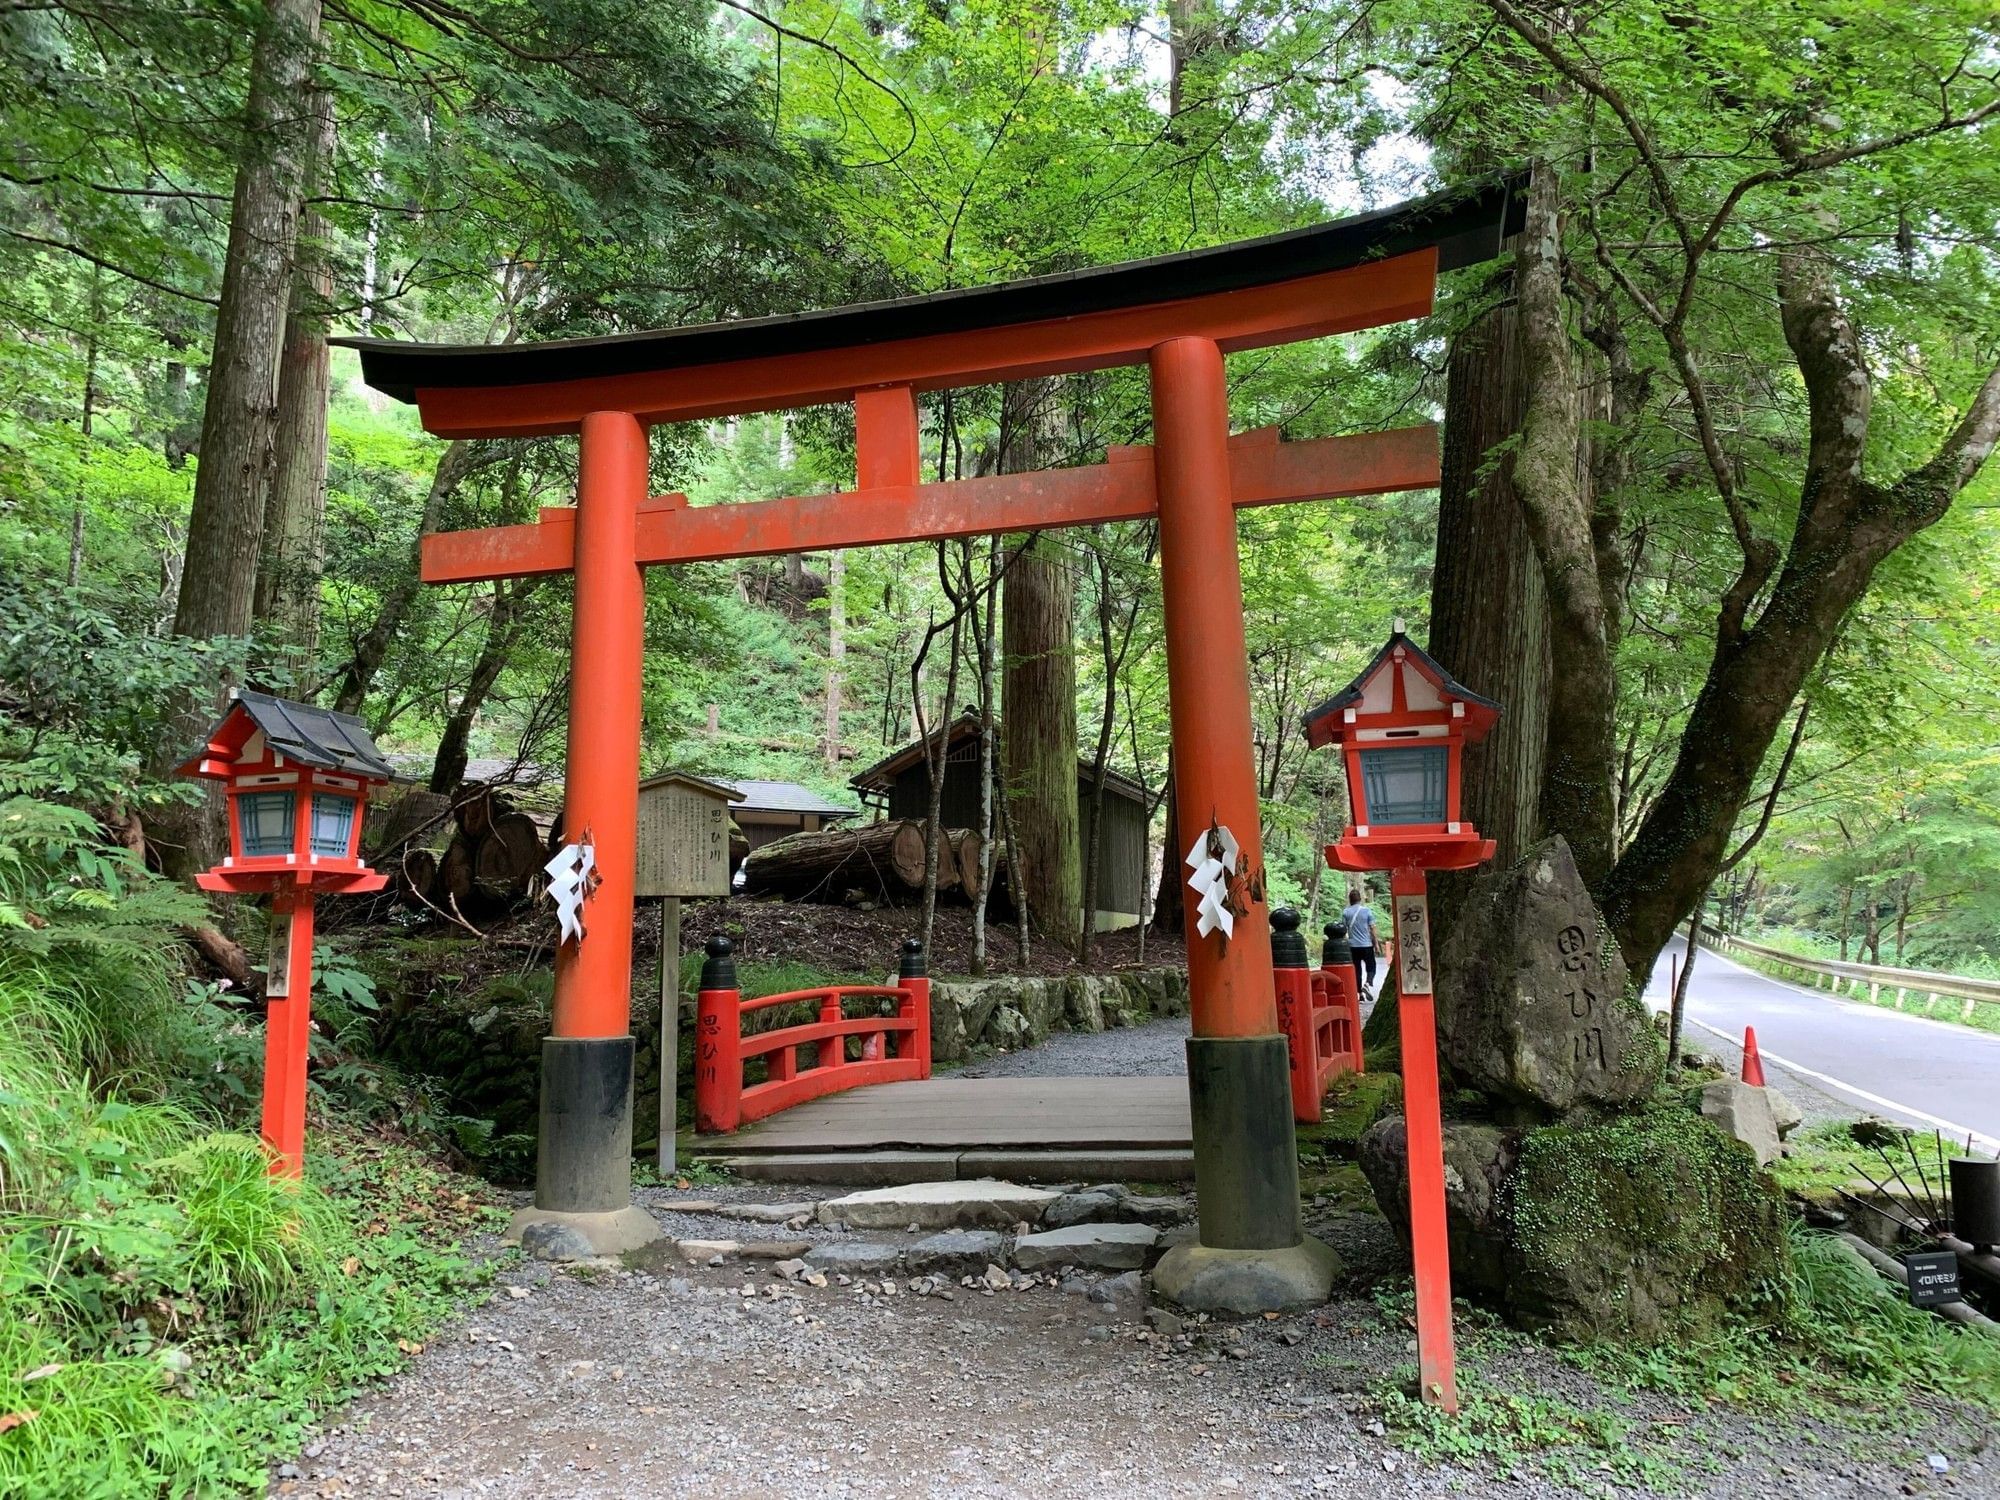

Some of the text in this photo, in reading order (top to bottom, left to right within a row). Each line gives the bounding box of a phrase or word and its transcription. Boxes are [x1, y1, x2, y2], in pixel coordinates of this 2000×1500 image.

[711, 809, 722, 862] 思ひ川
[1402, 908, 1428, 972] 右源太
[1556, 925, 1607, 1074] 思ひ川
[701, 1014, 721, 1084] 思ひ川
